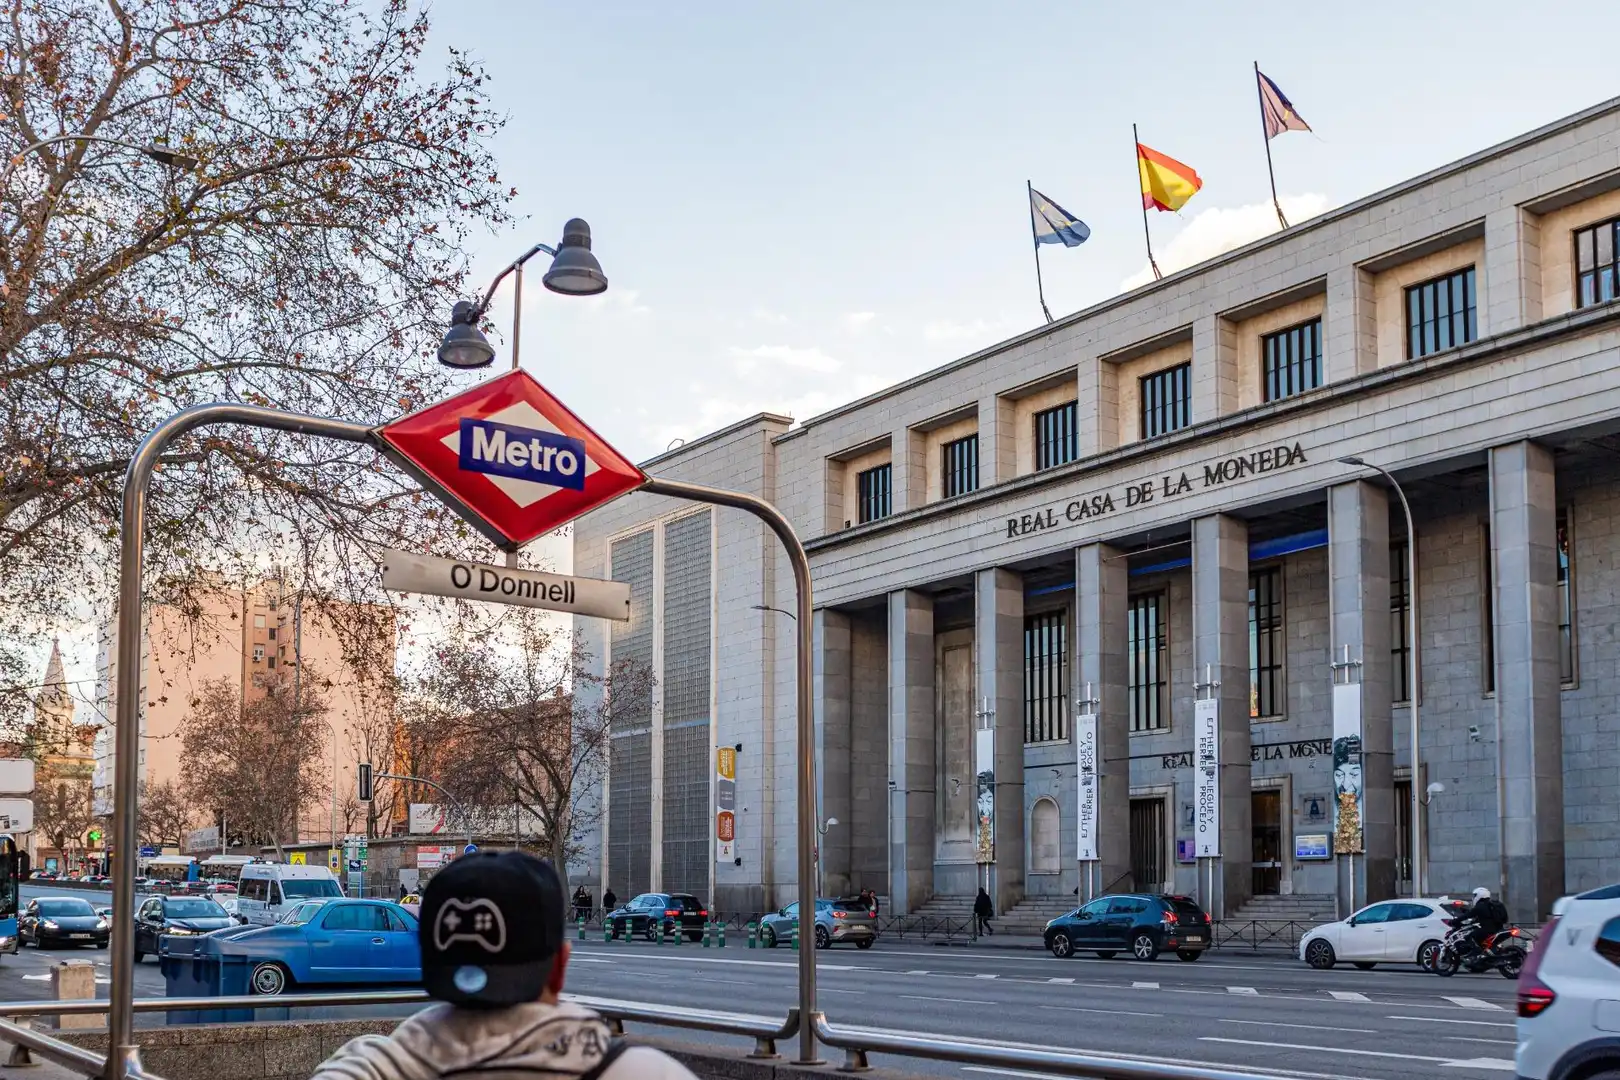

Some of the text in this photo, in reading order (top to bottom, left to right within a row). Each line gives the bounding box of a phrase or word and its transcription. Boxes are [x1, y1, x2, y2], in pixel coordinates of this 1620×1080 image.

[472, 426, 578, 476] Metro
[1007, 442, 1308, 538] REAL CASA DE LA MONEDA
[450, 563, 575, 604] O'Donnell
[1206, 717, 1214, 756] ESTHER
[1265, 746, 1283, 760] LA
[1289, 742, 1332, 759] MONE
[1199, 786, 1207, 833] PROCESO
[1206, 816, 1214, 824] Y
